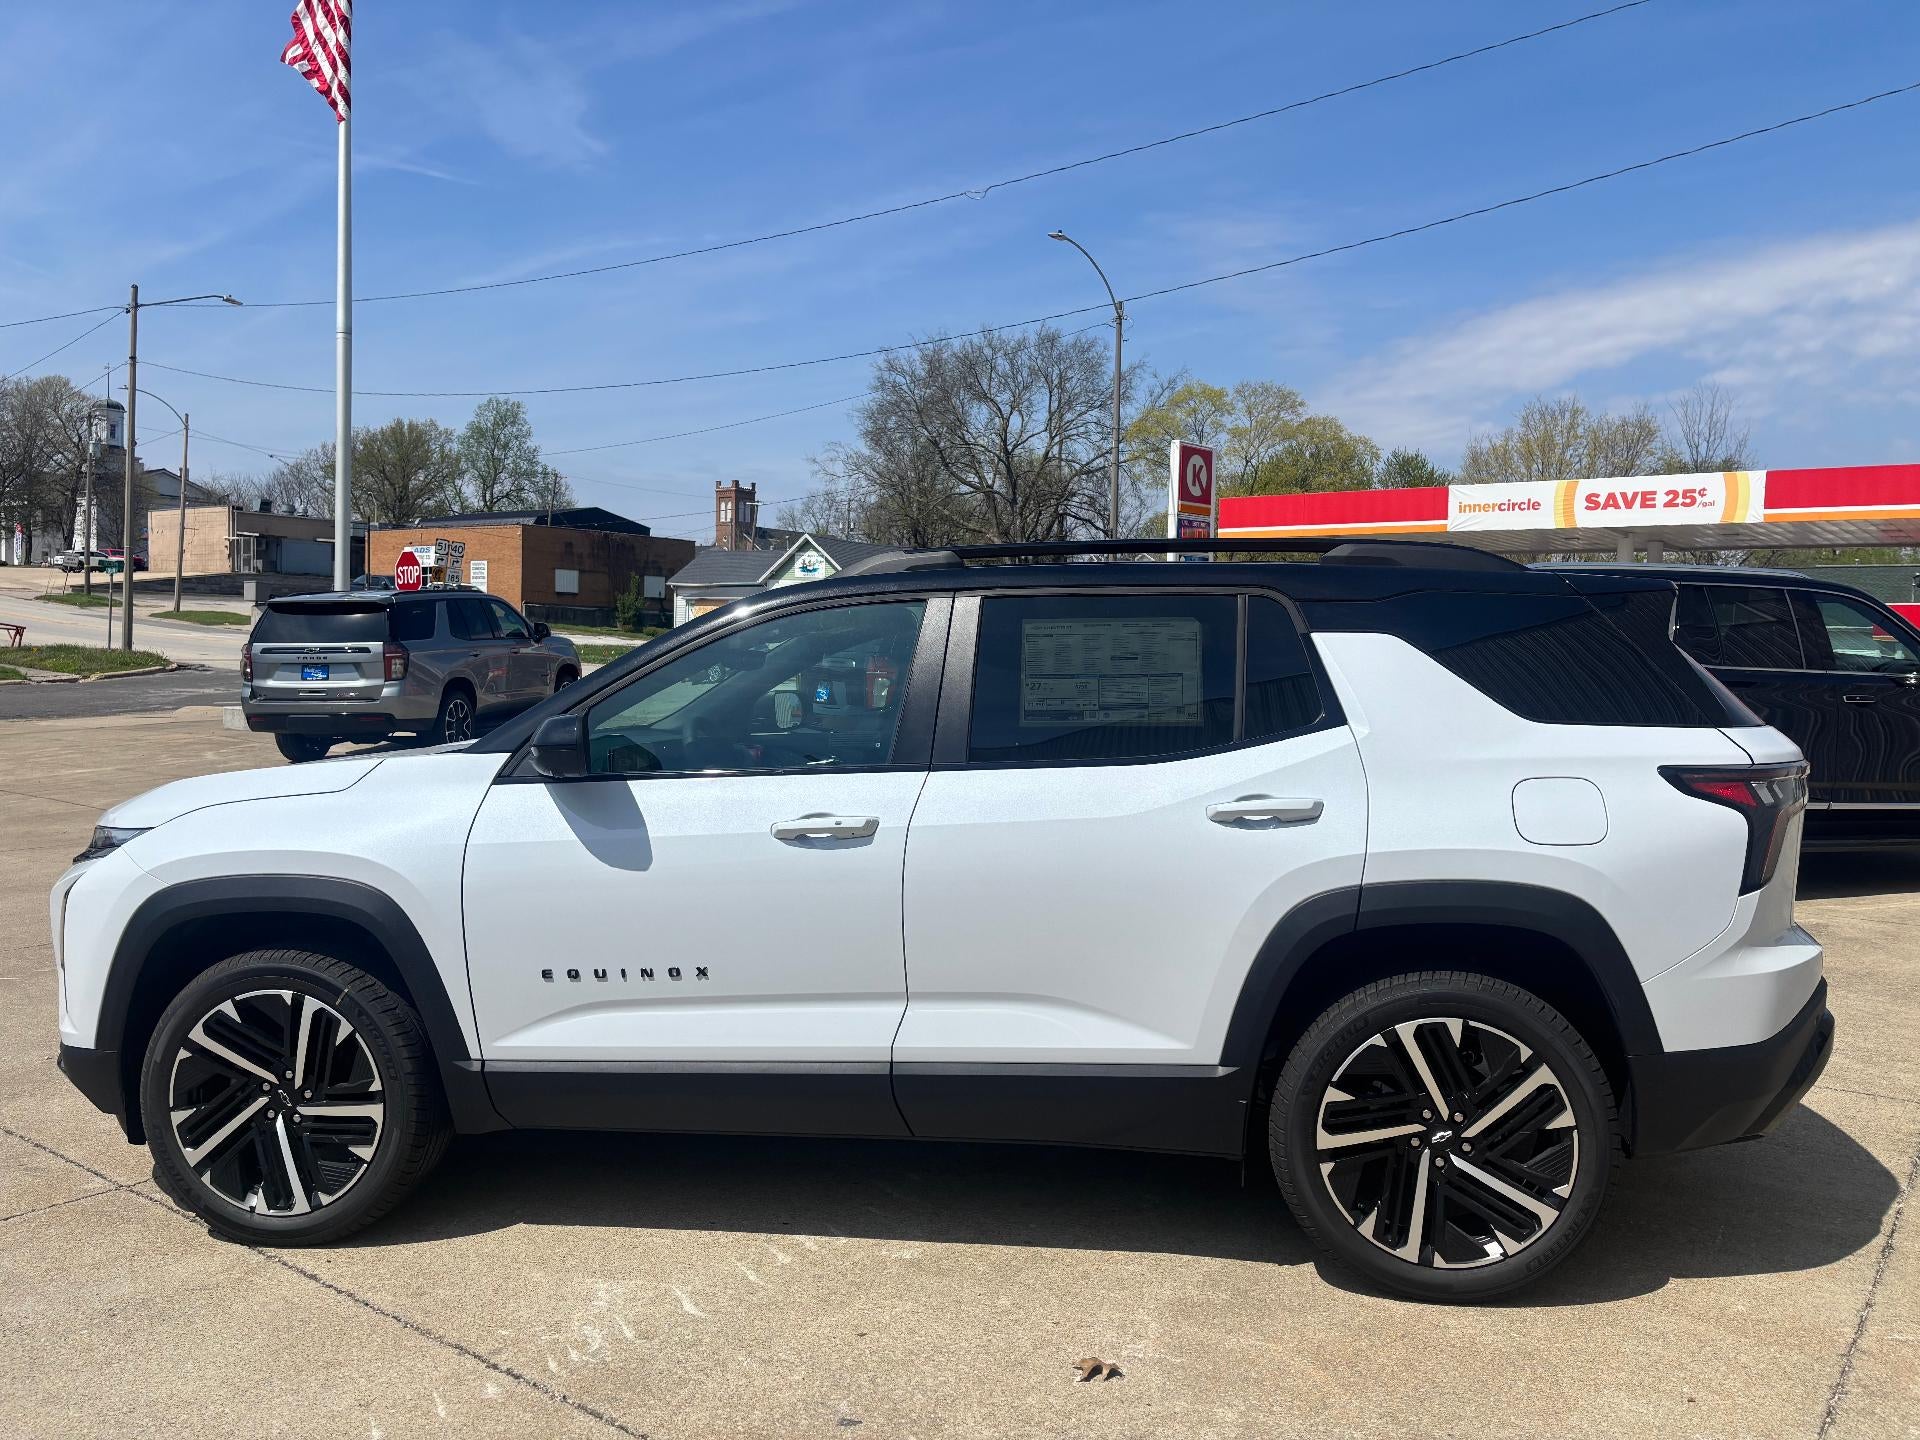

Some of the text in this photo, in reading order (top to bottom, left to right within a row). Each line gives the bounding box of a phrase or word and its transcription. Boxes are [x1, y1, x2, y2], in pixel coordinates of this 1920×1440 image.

[1192, 463, 1206, 496] K
[1458, 497, 1542, 514] innercircle
[1584, 490, 1657, 511] SAVE
[437, 542, 447, 552] 51
[453, 545, 464, 555] 40
[397, 566, 420, 585] STOP
[447, 574, 460, 583] 185
[541, 966, 709, 979] EQUINOX
